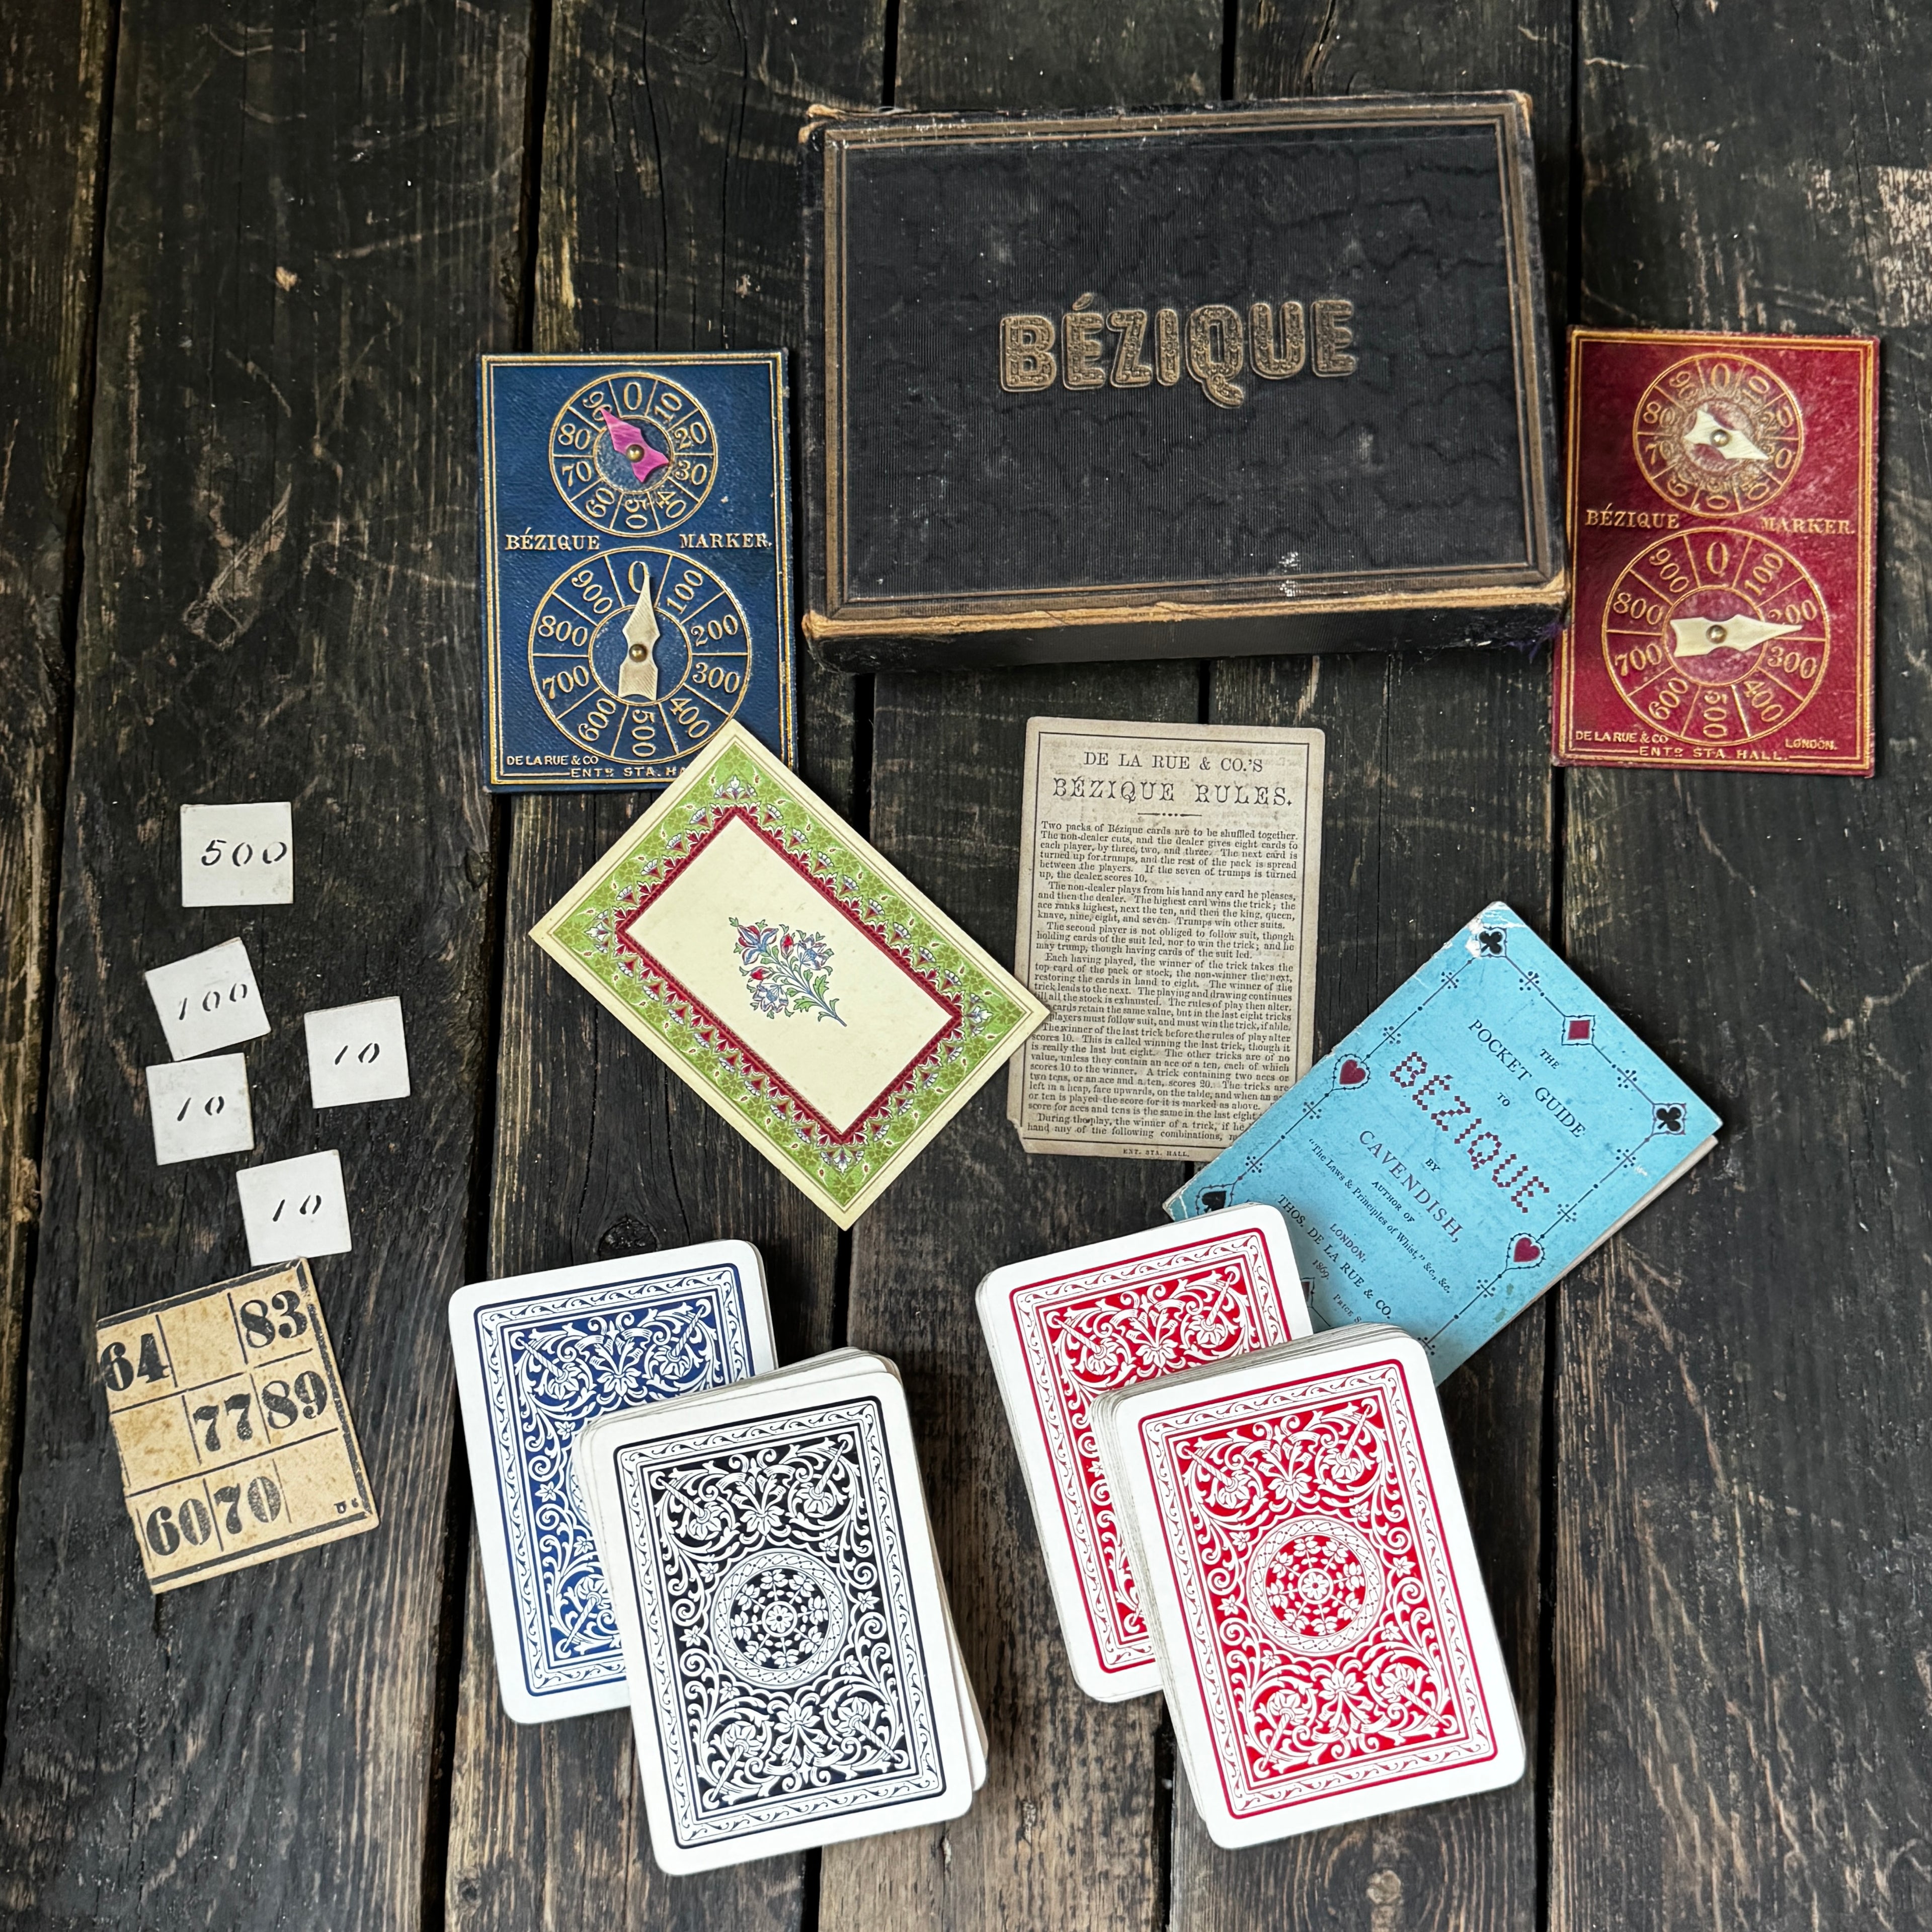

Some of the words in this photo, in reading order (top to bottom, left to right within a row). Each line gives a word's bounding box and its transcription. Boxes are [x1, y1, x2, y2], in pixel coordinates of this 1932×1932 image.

[1001, 293, 1356, 409] BÉZIQUE
[1670, 371, 1697, 399] 90
[1711, 364, 1730, 393] 0
[1742, 376, 1769, 403] 10
[583, 391, 612, 421] 90
[623, 382, 642, 410] 0
[655, 392, 681, 422] 10
[1643, 402, 1675, 428] 80
[558, 423, 590, 450] 80
[675, 423, 706, 448] 20
[1646, 441, 1673, 465] 70
[562, 461, 591, 488] 70
[675, 461, 706, 485] 30
[586, 488, 615, 518] 60
[625, 500, 648, 529] 50
[657, 490, 685, 519] 40
[1585, 503, 1679, 529] BÉZIQUE
[1761, 518, 1855, 535] MARKER.
[505, 527, 600, 550] BÉZIQUE
[680, 533, 772, 549] MARKER.
[1649, 548, 1689, 593] 900
[1706, 542, 1728, 575] 0
[1745, 552, 1783, 596] 100
[571, 570, 613, 614] 900
[667, 570, 703, 614] 100
[1613, 593, 1663, 625] 800
[538, 615, 588, 647] 800
[691, 615, 738, 646] 200
[1615, 643, 1661, 678] 700
[1767, 647, 1817, 679] 300
[542, 666, 589, 699] 700
[693, 663, 740, 693] 300
[1649, 678, 1688, 720] 600
[1744, 680, 1784, 722] 400
[578, 698, 616, 742] 600
[670, 698, 710, 738] 400
[1703, 691, 1727, 739] 500
[632, 710, 656, 757] 500
[1576, 731, 1592, 741] DE
[1594, 732, 1611, 742] LA
[1613, 732, 1638, 743] RUE
[1640, 732, 1650, 743] &
[507, 756, 522, 765] DE
[526, 756, 543, 765] LA
[545, 756, 568, 765] RUE
[1084, 752, 1108, 766] DE
[1119, 753, 1142, 768] LA
[1152, 755, 1190, 769] RUE
[1200, 758, 1211, 771] &
[1736, 750, 1787, 761] HALL.
[1053, 776, 1174, 803] BÉZIQUE
[1195, 784, 1292, 806] RULES.
[1041, 821, 1062, 830] Two
[1066, 823, 1090, 832] packs
[1095, 824, 1104, 832] of
[1108, 825, 1143, 835] Bézique
[1147, 827, 1170, 835] cards
[1194, 828, 1202, 836] to
[1206, 828, 1218, 837] be
[1258, 831, 1298, 841] together.
[1041, 831, 1058, 839] The
[1061, 833, 1108, 842] non-dealer
[1111, 835, 1132, 844] cuts,
[1158, 837, 1172, 845] the
[1176, 837, 1204, 845] dealer
[1208, 839, 1231, 849] gives
[1235, 840, 1257, 849] eight
[1261, 841, 1285, 849] cards
[201, 840, 287, 866] 500
[1039, 871, 1053, 879] up,
[1057, 870, 1071, 879] the
[1134, 874, 1147, 882] 10.
[1045, 953, 1067, 962] Each
[1072, 954, 1101, 964] having
[1104, 956, 1136, 967] played,
[1141, 957, 1155, 966] the
[1159, 958, 1191, 968] winner
[1195, 958, 1204, 968] of
[1209, 960, 1223, 969] the
[1226, 961, 1247, 970] trick
[1278, 963, 1293, 972] the
[179, 983, 248, 1020] 100
[335, 1043, 379, 1065] 10
[1540, 1049, 1559, 1069] THE
[1468, 1019, 1532, 1081] POCKET
[1535, 1087, 1586, 1138] GUIDE
[177, 1096, 224, 1121] 10
[1070, 1093, 1098, 1104] played
[1103, 1095, 1117, 1103] the
[1147, 1097, 1159, 1105] for
[1163, 1098, 1169, 1106] it
[1172, 1098, 1179, 1106] is
[1183, 1099, 1217, 1108] marked
[1232, 1101, 1260, 1110] above.
[1497, 1092, 1510, 1107] TO
[1390, 1052, 1550, 1213] BÉZIQUE
[1425, 1158, 1440, 1173] BY
[1359, 1131, 1463, 1243] CAVENDISH,
[1372, 1181, 1402, 1211] AUTHOR
[1404, 1213, 1415, 1223] OF
[273, 1194, 321, 1222] 10
[1325, 1161, 1344, 1181] Laws
[1345, 1179, 1352, 1189] &
[1352, 1187, 1387, 1226] Principles
[1387, 1224, 1399, 1235] of
[1438, 1278, 1450, 1293] &c.
[1278, 1194, 1305, 1228] THOS.
[1307, 1228, 1324, 1245] DE
[1324, 1244, 1339, 1262] LA
[1340, 1262, 1365, 1287] RUE
[1364, 1289, 1373, 1299] &
[1376, 1300, 1391, 1319] CO.
[1330, 1224, 1366, 1263] LONDON:
[1312, 1260, 1330, 1279] 1869.
[240, 1290, 307, 1348] 83
[100, 1333, 171, 1391] 64
[262, 1371, 327, 1429] 89
[193, 1394, 252, 1452] 77
[214, 1476, 281, 1535] 70
[146, 1499, 211, 1555] 60
